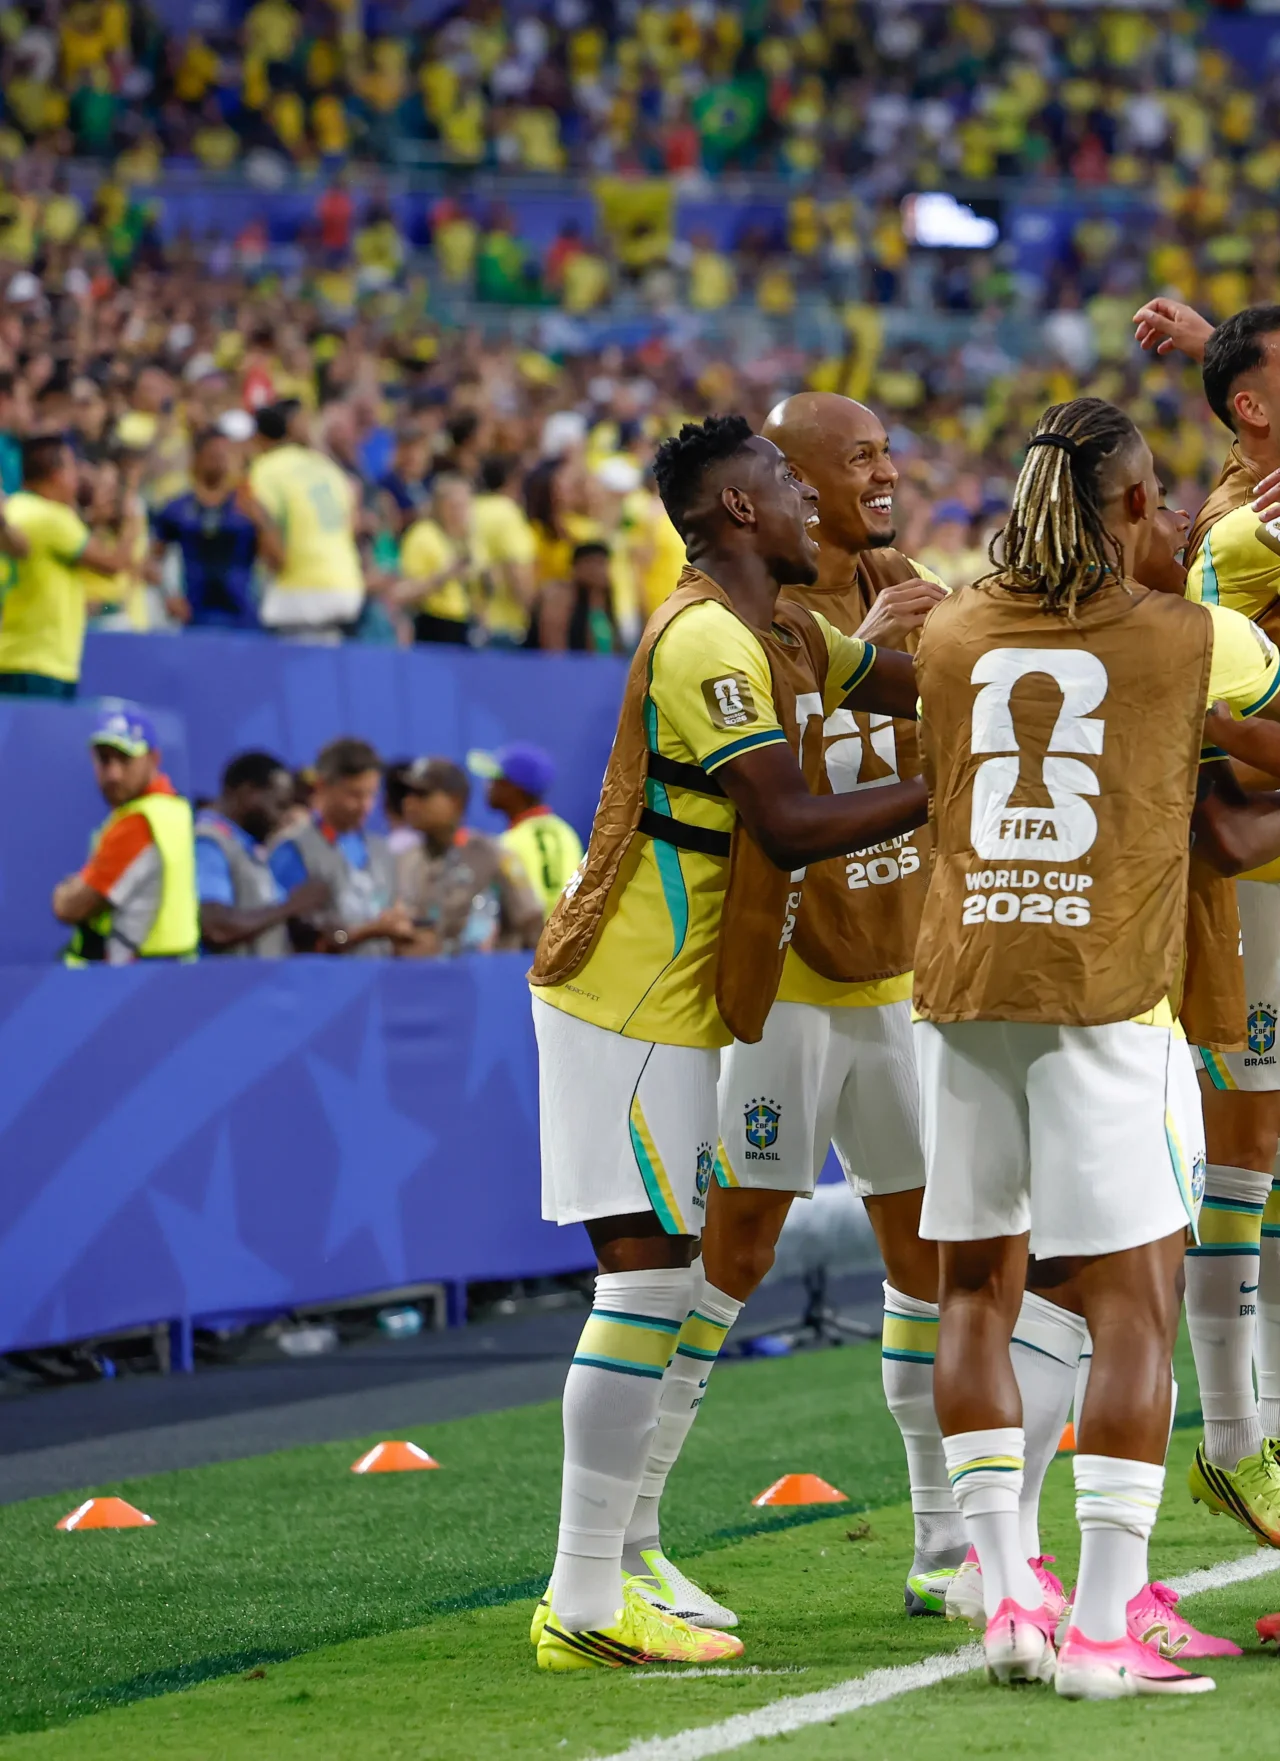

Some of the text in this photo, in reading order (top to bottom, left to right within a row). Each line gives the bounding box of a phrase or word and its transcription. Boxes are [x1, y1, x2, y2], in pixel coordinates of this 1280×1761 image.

[999, 819, 1059, 841] FIFA
[965, 870, 1093, 893] WORLD CUP
[962, 892, 1092, 927] 2026
[1244, 1055, 1277, 1067] BRASIL
[745, 1151, 780, 1160] BRASIL
